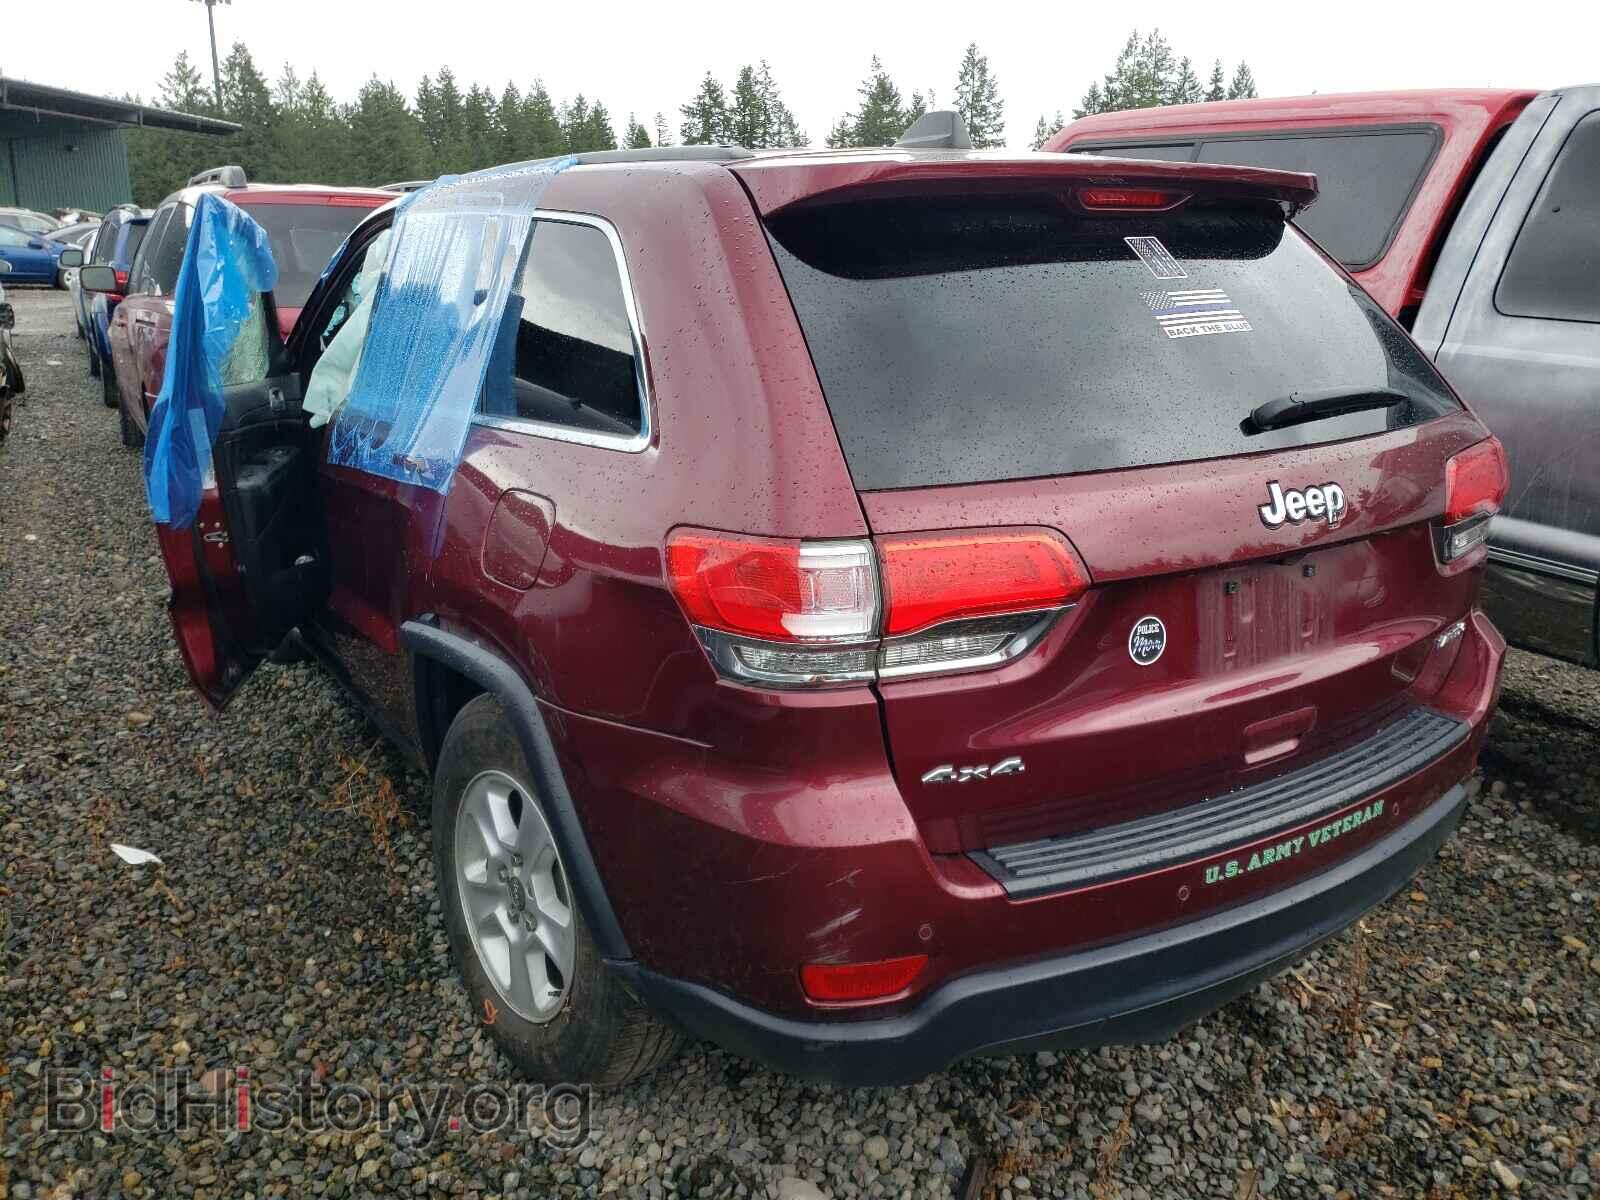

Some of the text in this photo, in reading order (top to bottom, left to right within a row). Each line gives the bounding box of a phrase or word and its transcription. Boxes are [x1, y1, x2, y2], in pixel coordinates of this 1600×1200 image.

[1167, 320, 1250, 337] BACK THE BLUE
[1257, 480, 1346, 529] Jeep
[1136, 623, 1160, 636] POLICE
[1205, 800, 1385, 884] U.S. ARMY VETERAN
